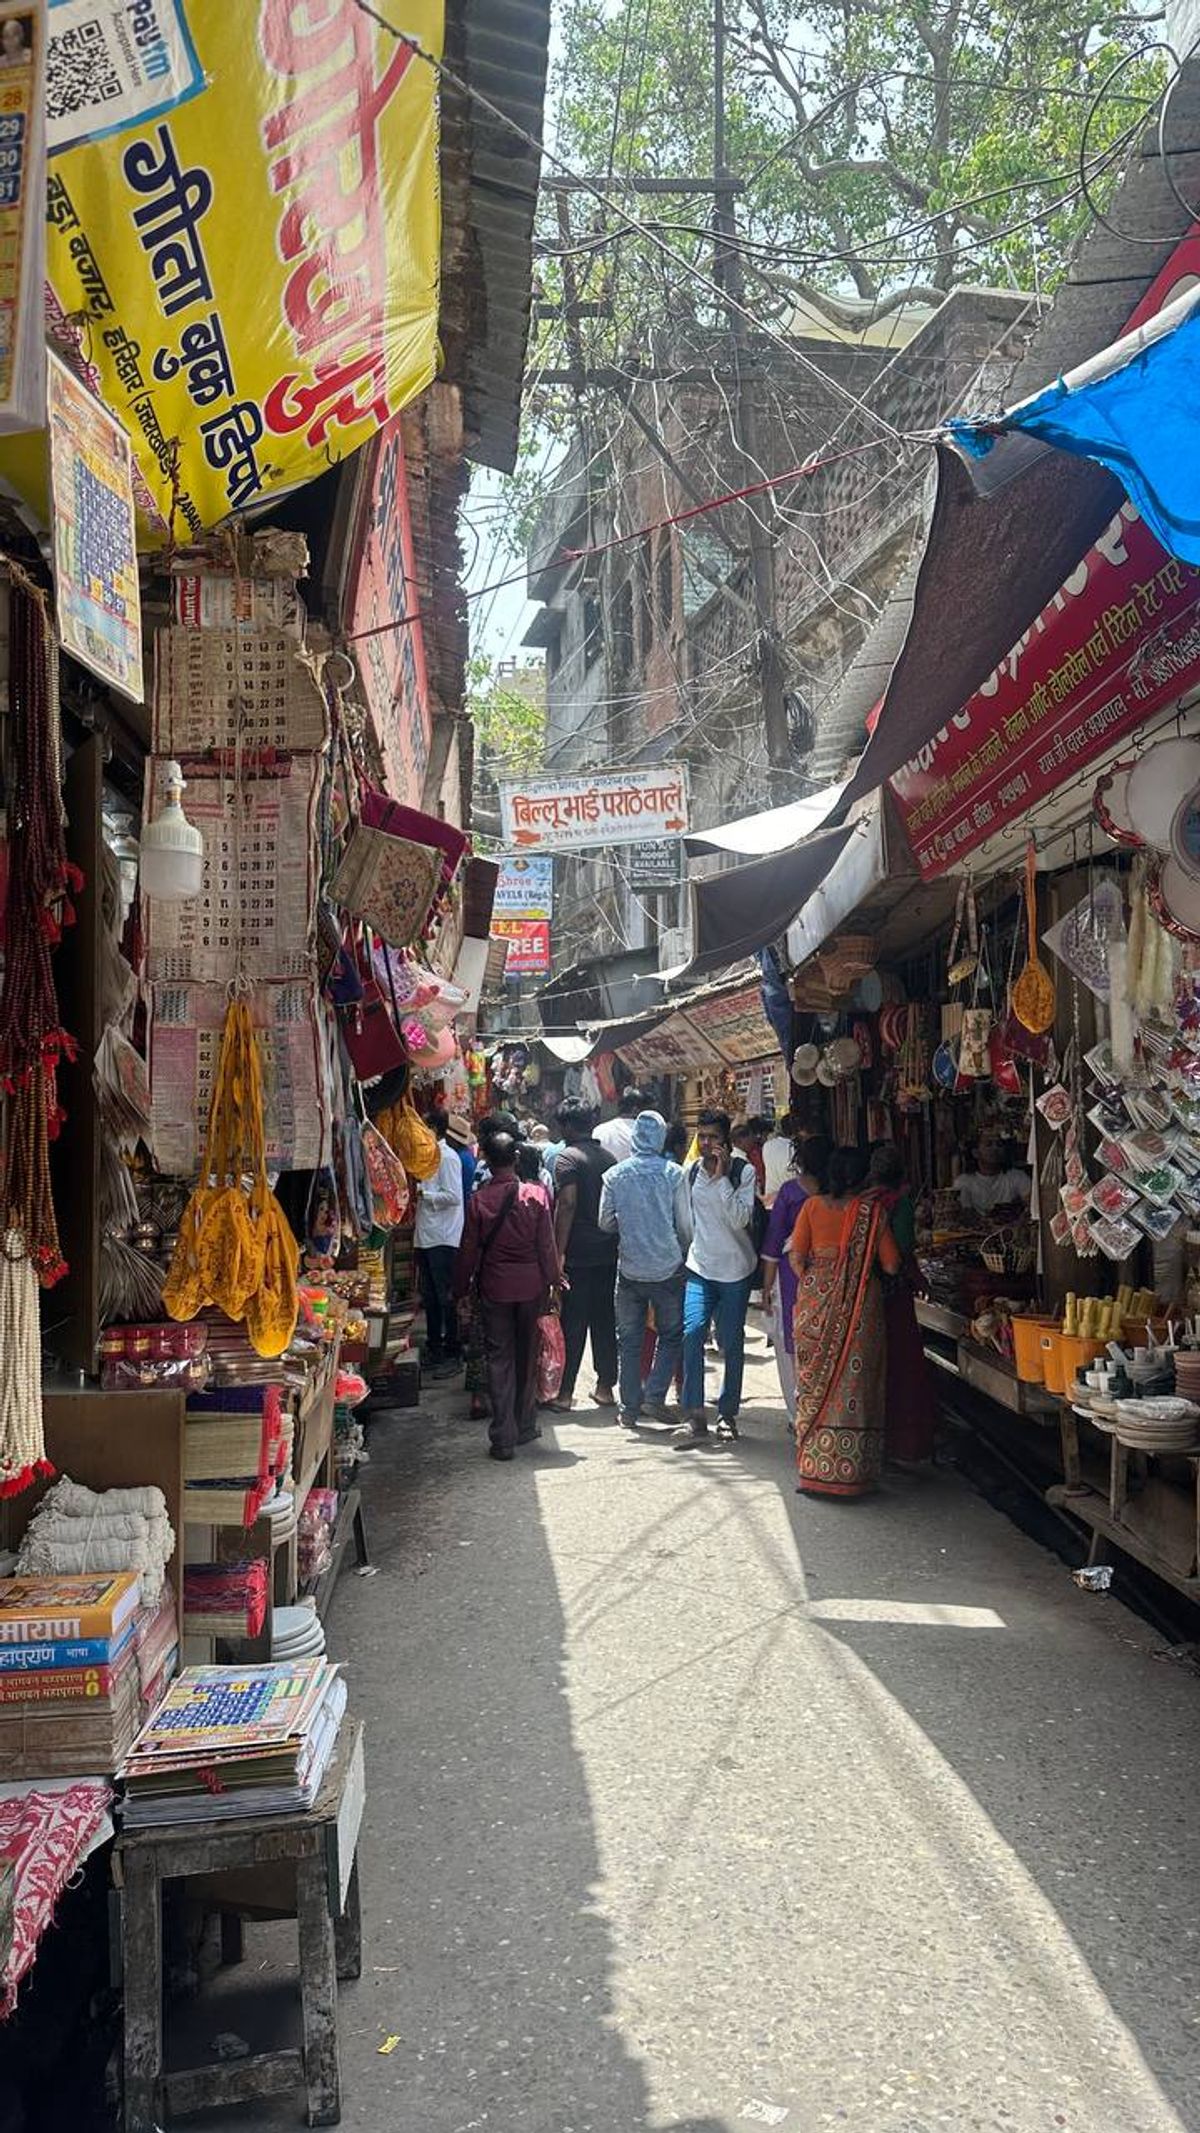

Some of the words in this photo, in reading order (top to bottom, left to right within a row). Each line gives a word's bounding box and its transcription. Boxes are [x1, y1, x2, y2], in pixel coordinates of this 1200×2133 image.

[124, 126, 212, 317] गीता
[154, 312, 235, 405] बुक
[1027, 681, 1054, 724] आदि
[1156, 558, 1188, 596] पर
[261, 680, 270, 689] 21
[1085, 693, 1128, 738] अग्रवाल
[512, 796, 569, 829] बिल्लू
[204, 861, 210, 870] 2
[219, 919, 229, 927] 12
